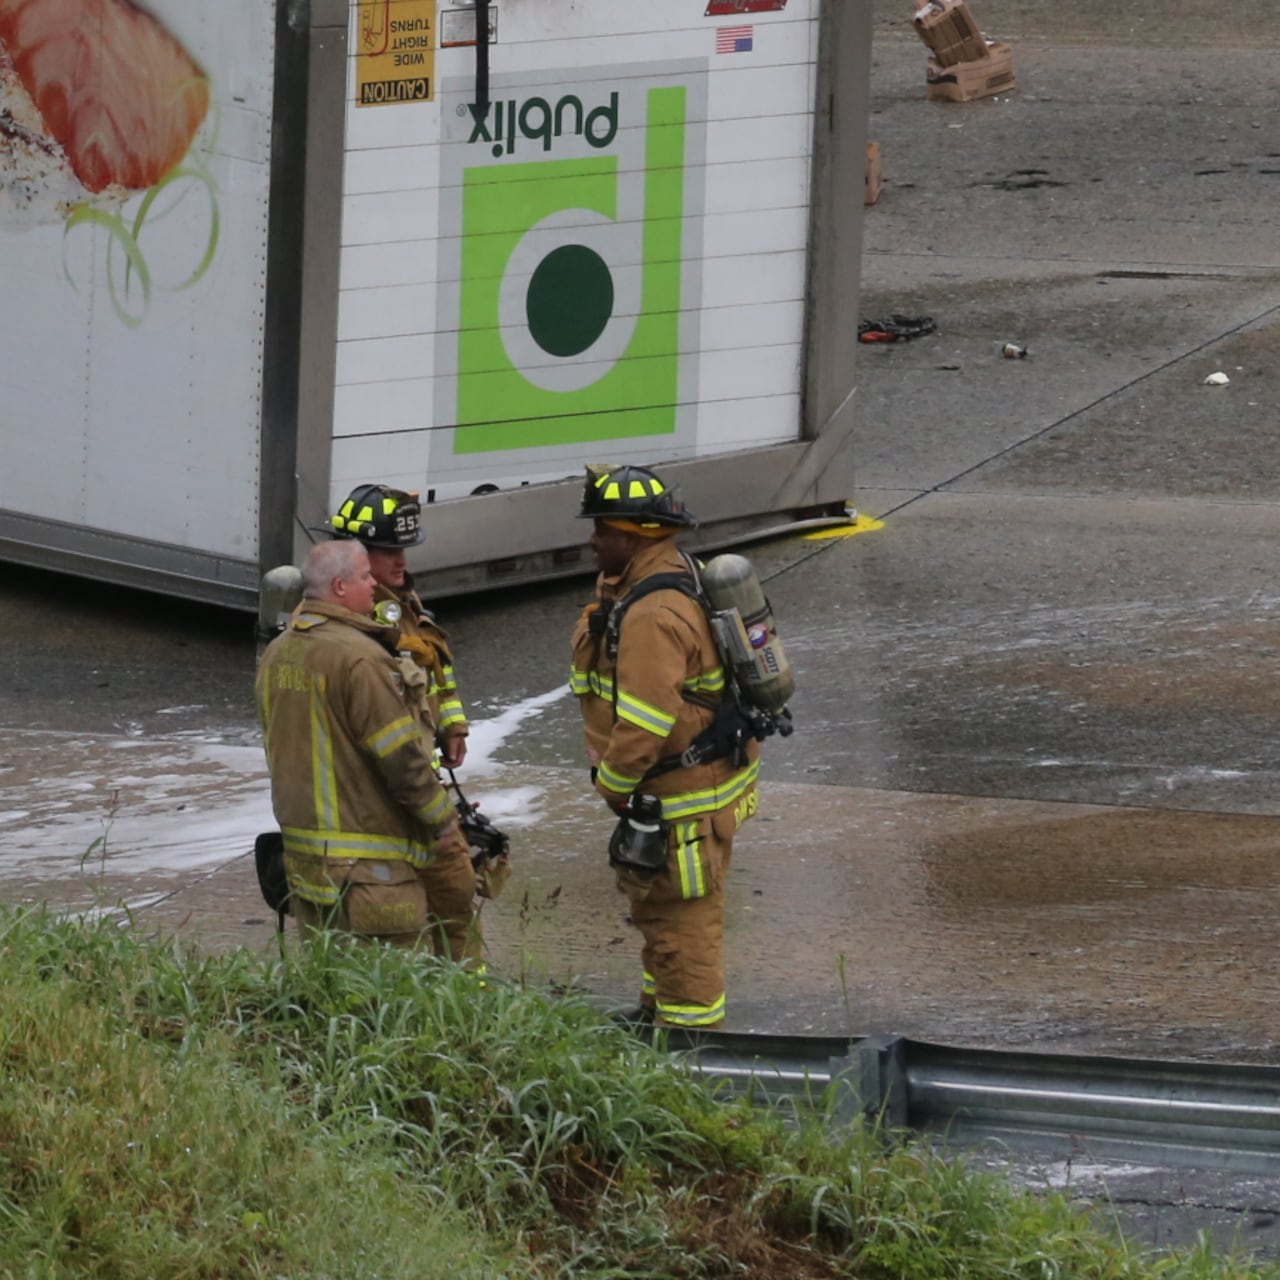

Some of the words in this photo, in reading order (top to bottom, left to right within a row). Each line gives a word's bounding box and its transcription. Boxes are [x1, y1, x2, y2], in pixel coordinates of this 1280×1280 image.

[390, 18, 431, 33] TURNS
[391, 36, 428, 50] RIGHT
[393, 54, 425, 67] WIDE
[362, 78, 427, 103] CAUTION
